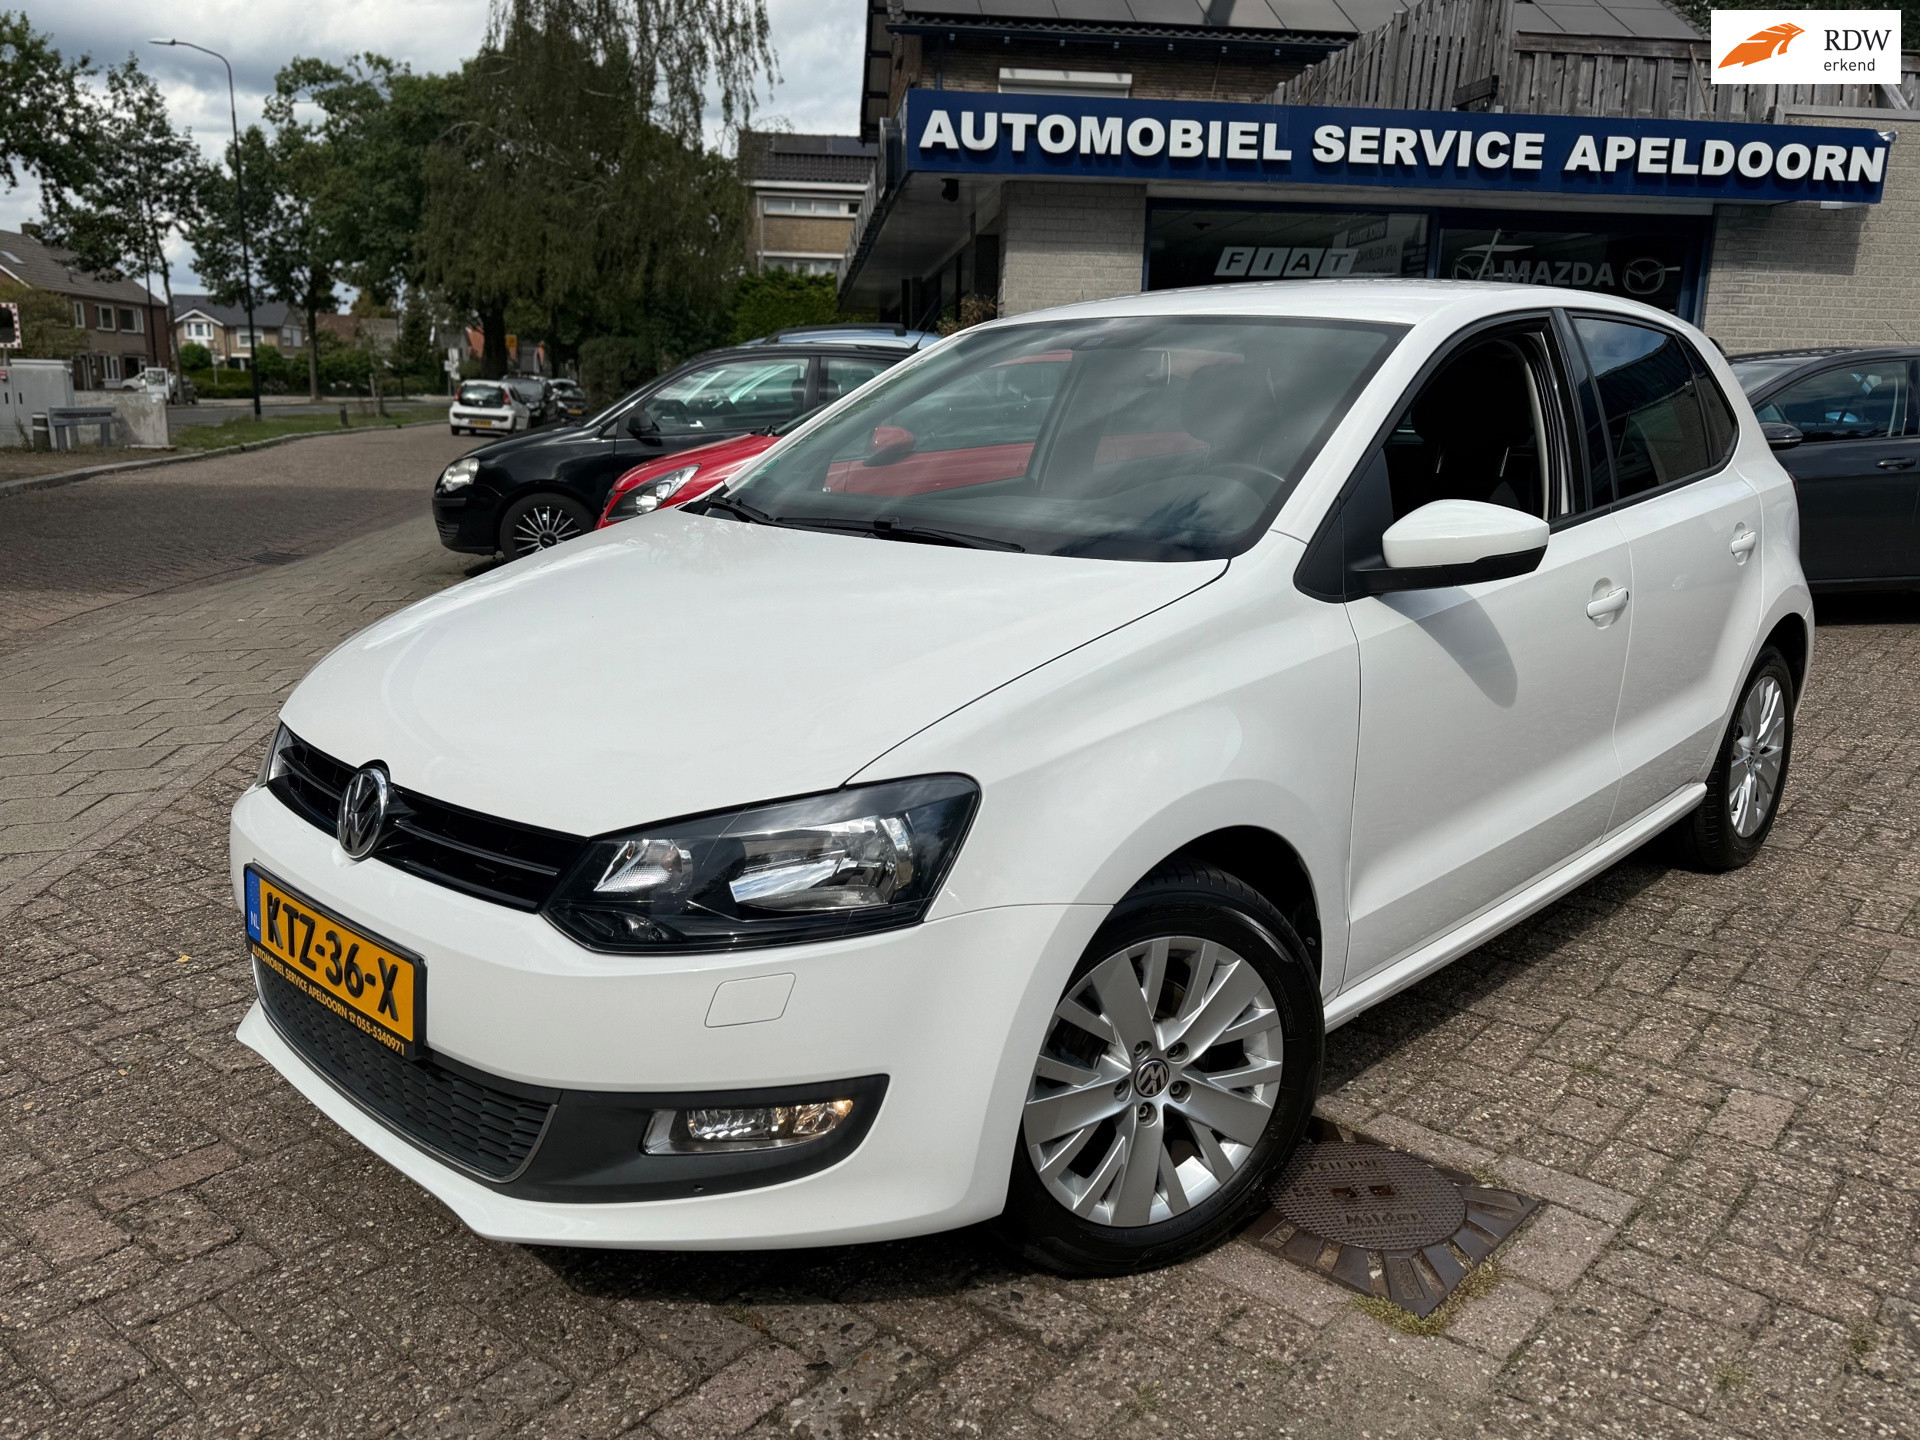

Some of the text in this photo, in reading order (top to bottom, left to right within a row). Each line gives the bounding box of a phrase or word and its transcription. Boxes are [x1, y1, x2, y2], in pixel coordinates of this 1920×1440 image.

[919, 109, 1885, 183] AUTOMOBIEL SERVICE APELDOORN
[1221, 250, 1351, 274] FIAT
[1502, 259, 1615, 286] MAZDA
[250, 910, 260, 930] NL
[266, 892, 399, 1022] KTZ-36-X
[252, 944, 405, 1056] AUTOMOBIEL SERVICE APELDOORN 055-5340971
